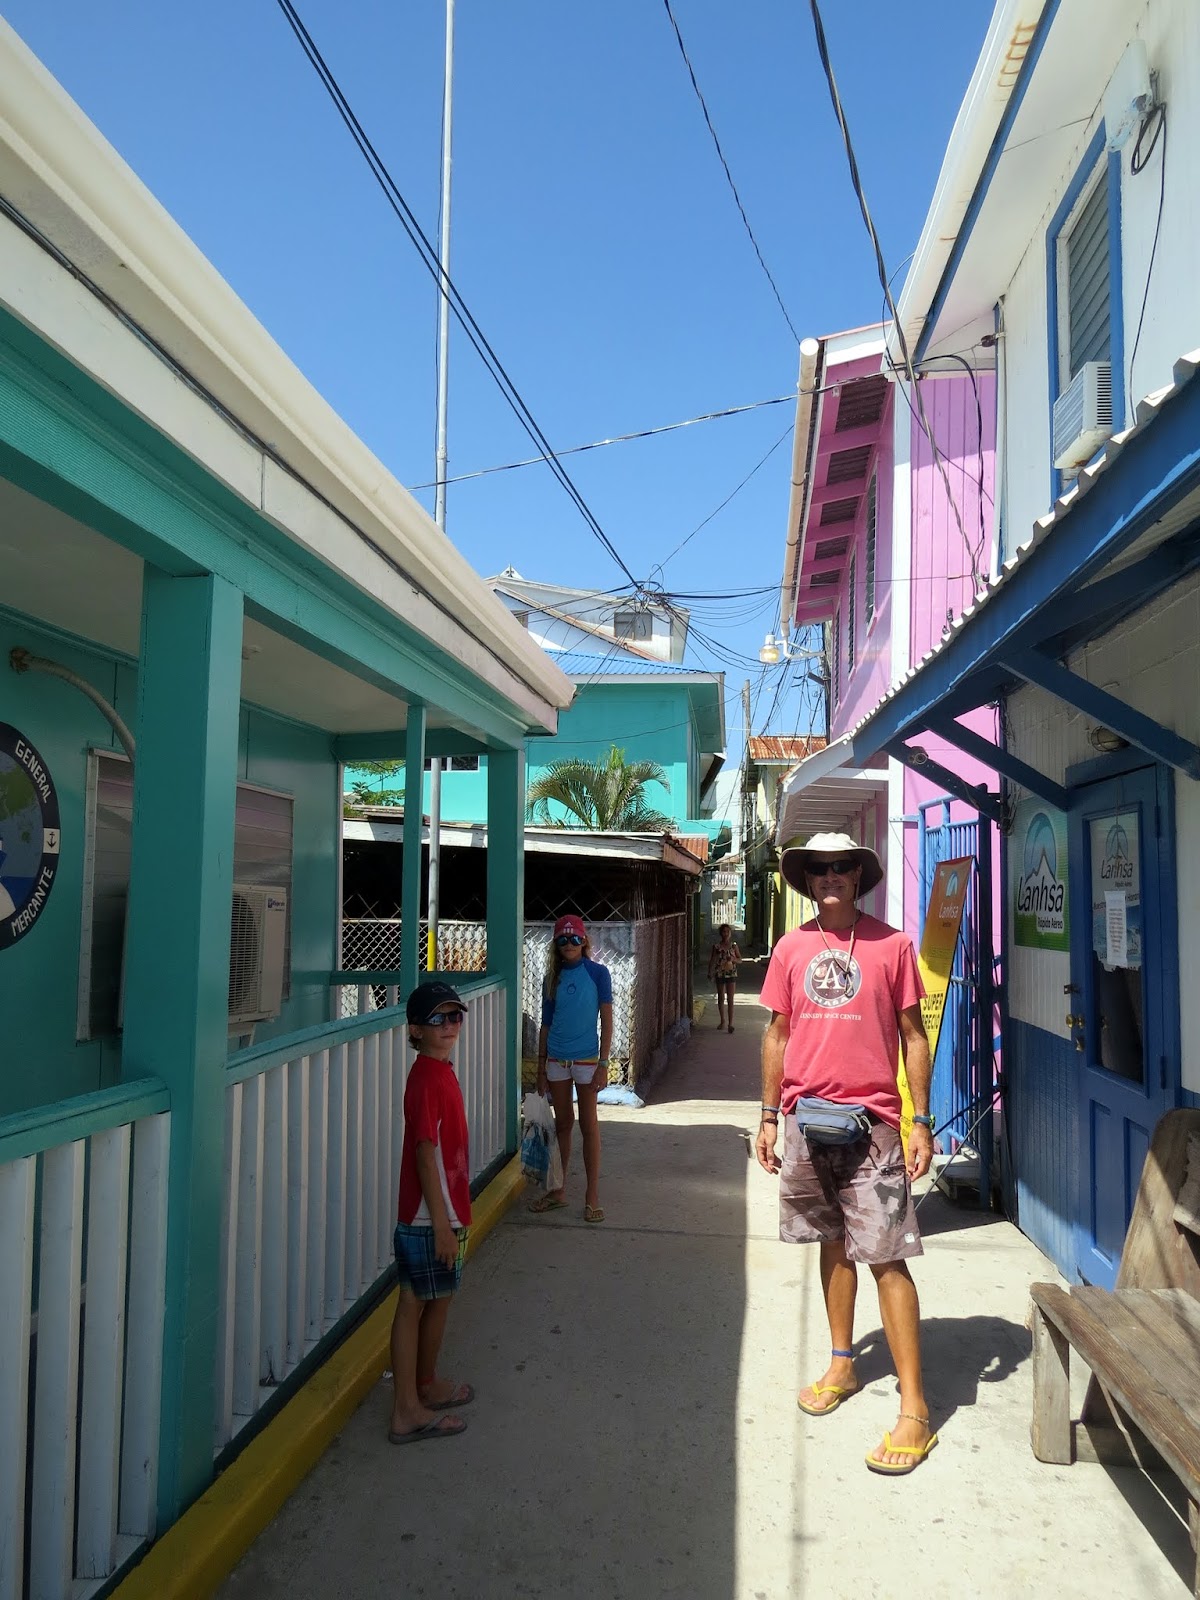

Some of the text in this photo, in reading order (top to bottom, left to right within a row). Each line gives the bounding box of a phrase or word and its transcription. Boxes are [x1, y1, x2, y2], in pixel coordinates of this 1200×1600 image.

[15, 739, 52, 804] GENERAL
[1101, 859, 1133, 879] Lanhsa
[11, 866, 54, 937] MERCANTE
[1017, 875, 1064, 913] Lanhsa
[938, 902, 959, 919] Lanhsa
[810, 951, 857, 971] APOLLO
[814, 995, 849, 1006] NASA
[923, 993, 944, 1011] SUPER
[840, 1013, 862, 1021] CENTER
